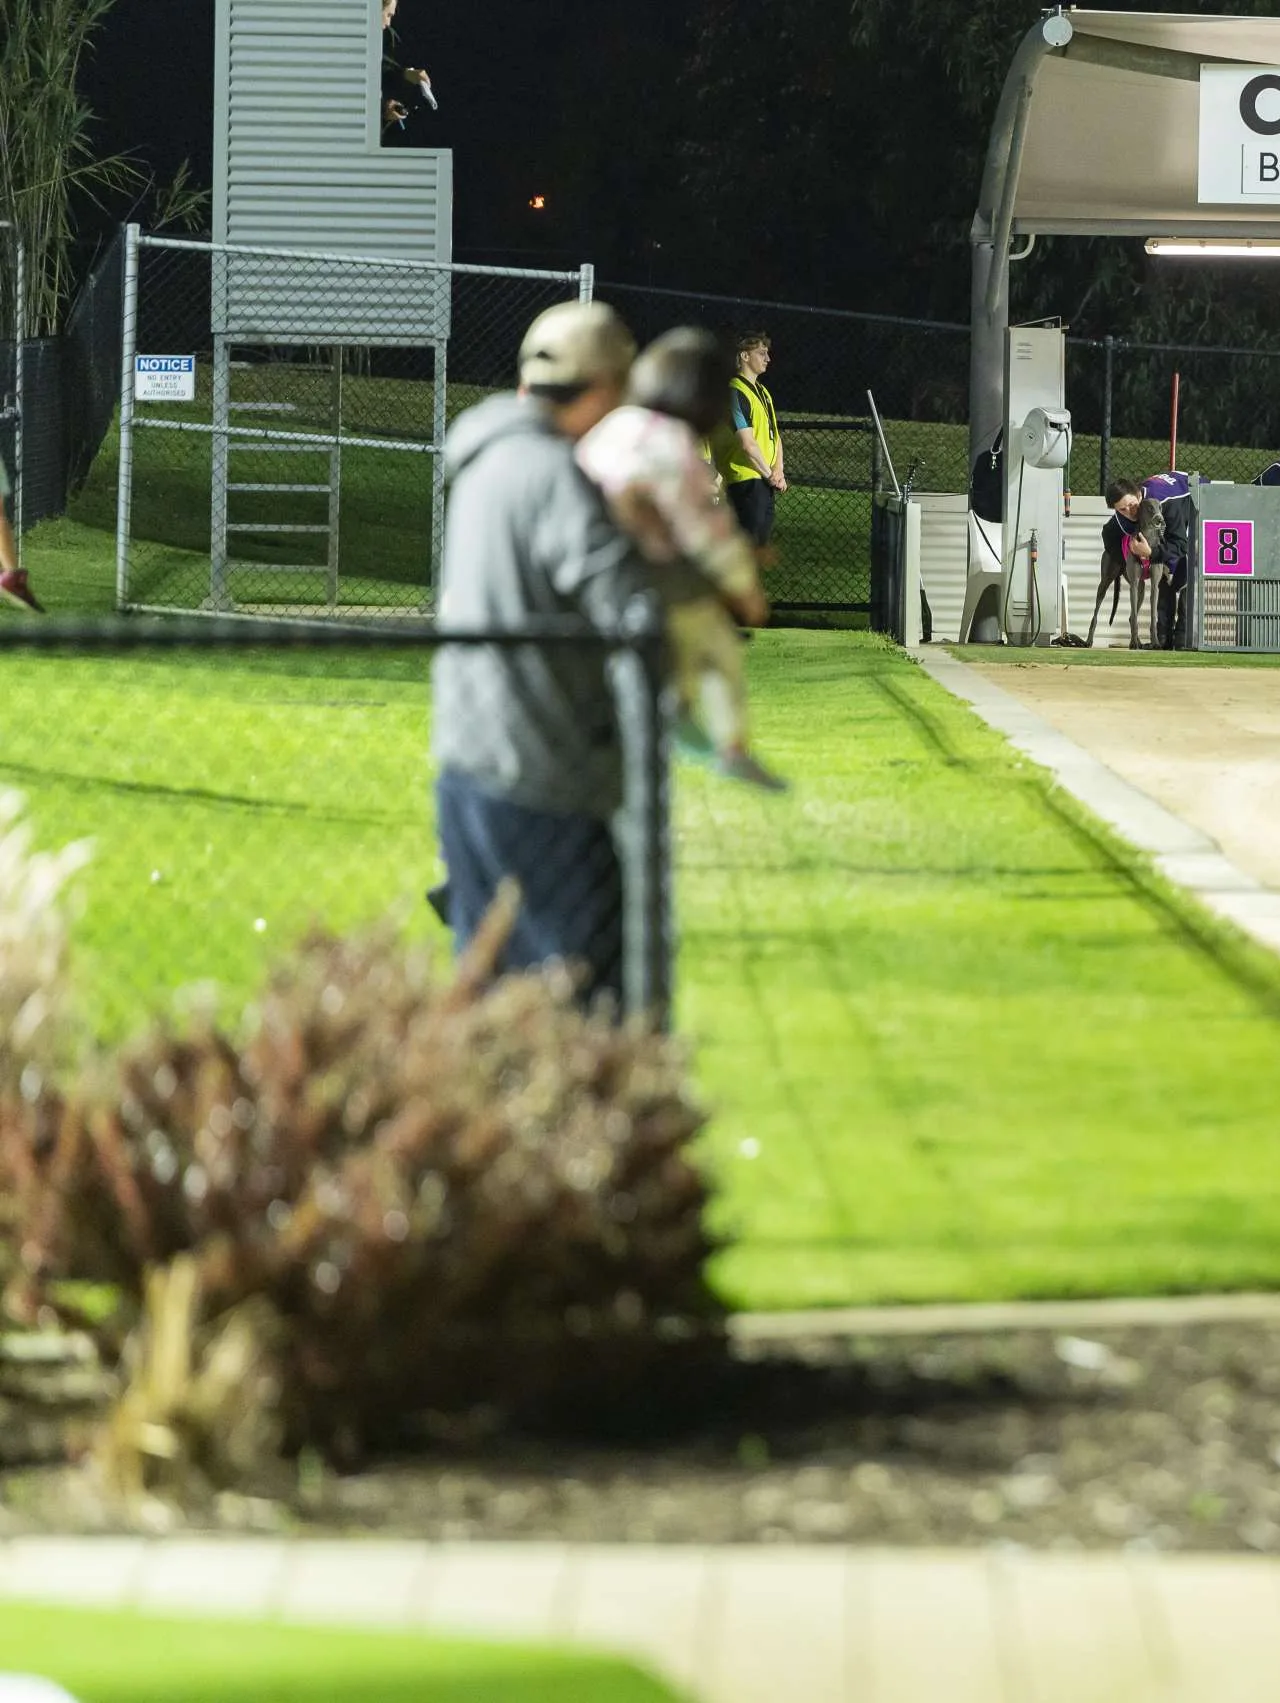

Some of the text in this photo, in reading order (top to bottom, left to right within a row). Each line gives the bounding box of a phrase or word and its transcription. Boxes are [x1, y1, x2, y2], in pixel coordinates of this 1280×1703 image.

[140, 359, 189, 371] NOTICE
[143, 389, 186, 397] AUTHORISED
[1218, 528, 1238, 566] 8
